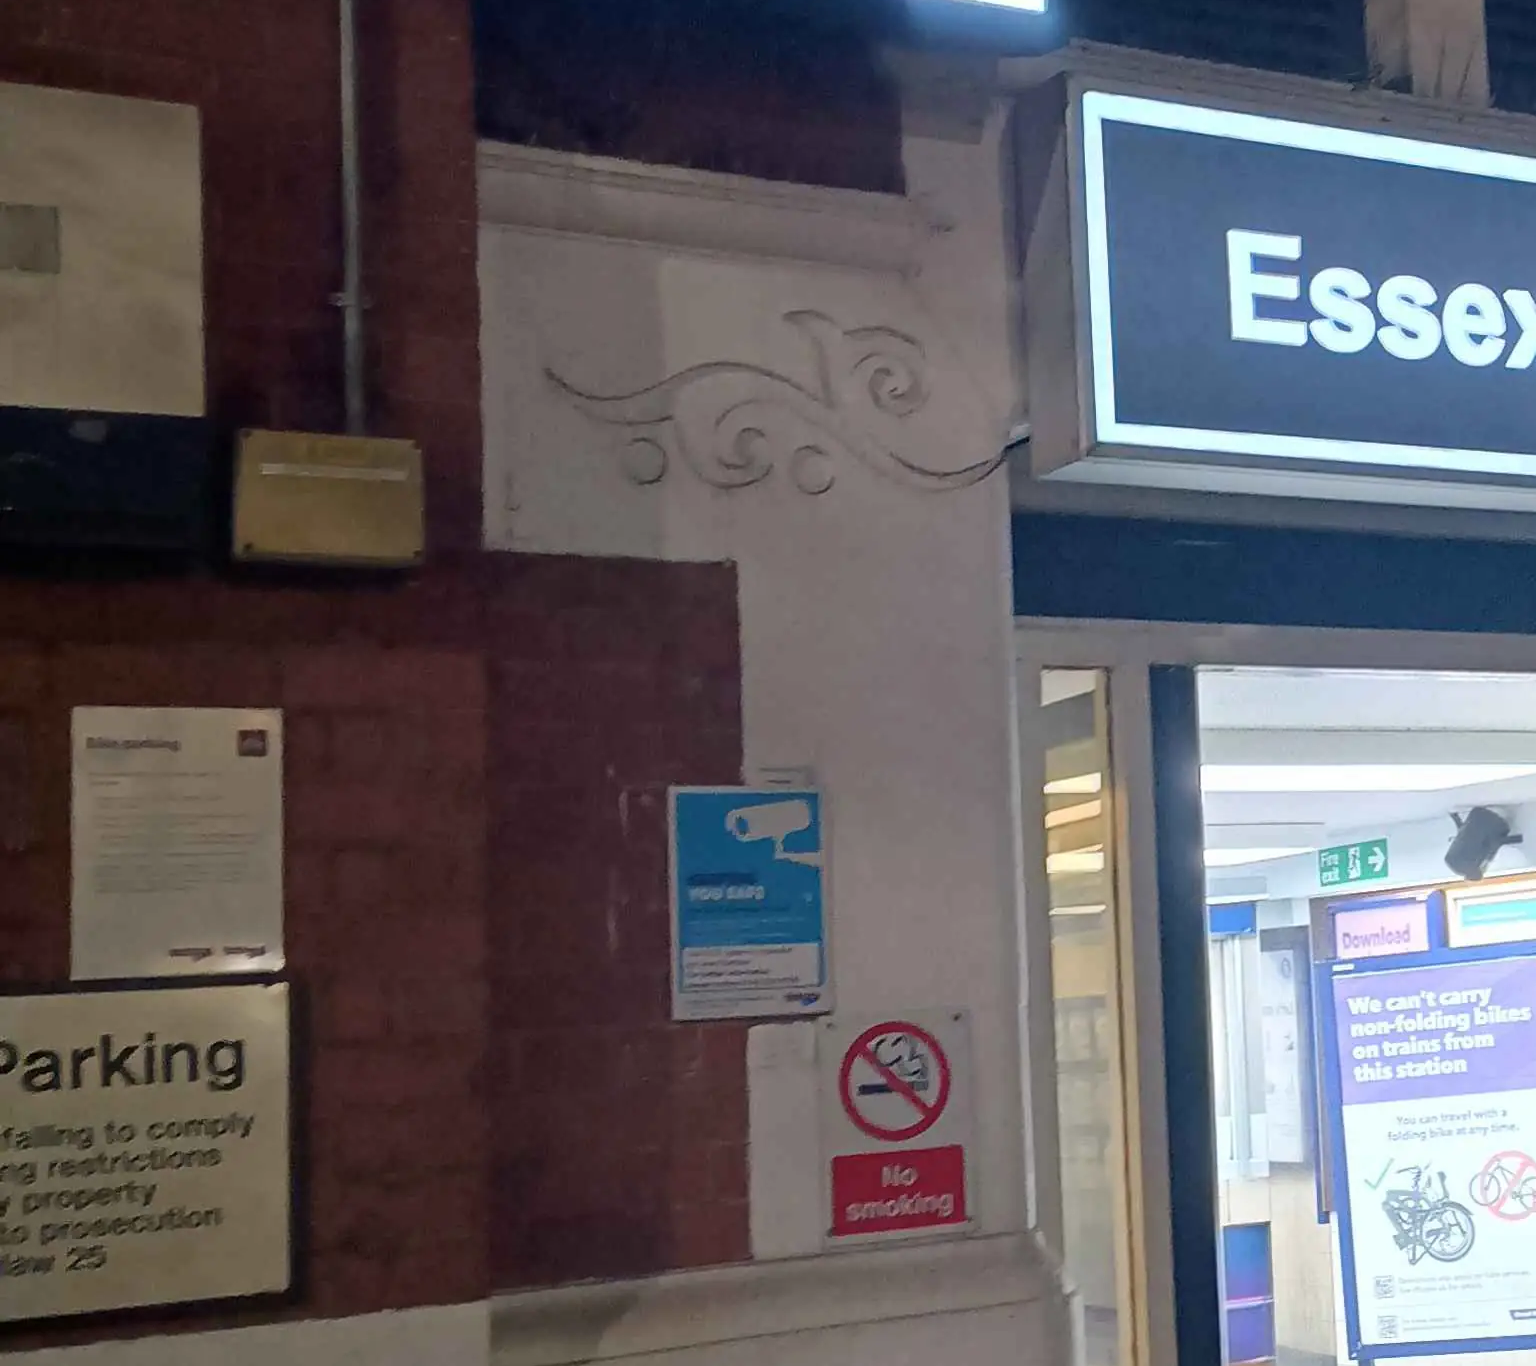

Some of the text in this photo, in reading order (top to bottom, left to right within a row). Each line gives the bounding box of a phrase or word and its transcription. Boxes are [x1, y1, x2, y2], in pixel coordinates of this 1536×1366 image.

[1320, 851, 1340, 868] Fire
[1342, 924, 1411, 950] Download
[1347, 987, 1492, 1015] We can't carry
[1350, 1005, 1533, 1037] non-folding bikes
[1352, 1032, 1495, 1059] on trains from
[1353, 1056, 1468, 1083] this station
[105, 1119, 137, 1145] to
[146, 1111, 256, 1140] comply
[1396, 1115, 1416, 1126] You
[1419, 1115, 1439, 1125] can
[1440, 1110, 1472, 1122] travel
[1474, 1108, 1499, 1119] with
[1387, 1130, 1427, 1142] folding
[1429, 1126, 1454, 1139] bike
[1456, 1126, 1468, 1136] at
[1468, 1126, 1490, 1138] any
[48, 1146, 223, 1179] restrictions
[881, 1163, 919, 1188] No
[22, 1181, 158, 1217] property
[846, 1190, 955, 1222] smoking
[40, 1205, 224, 1247] prosecution
